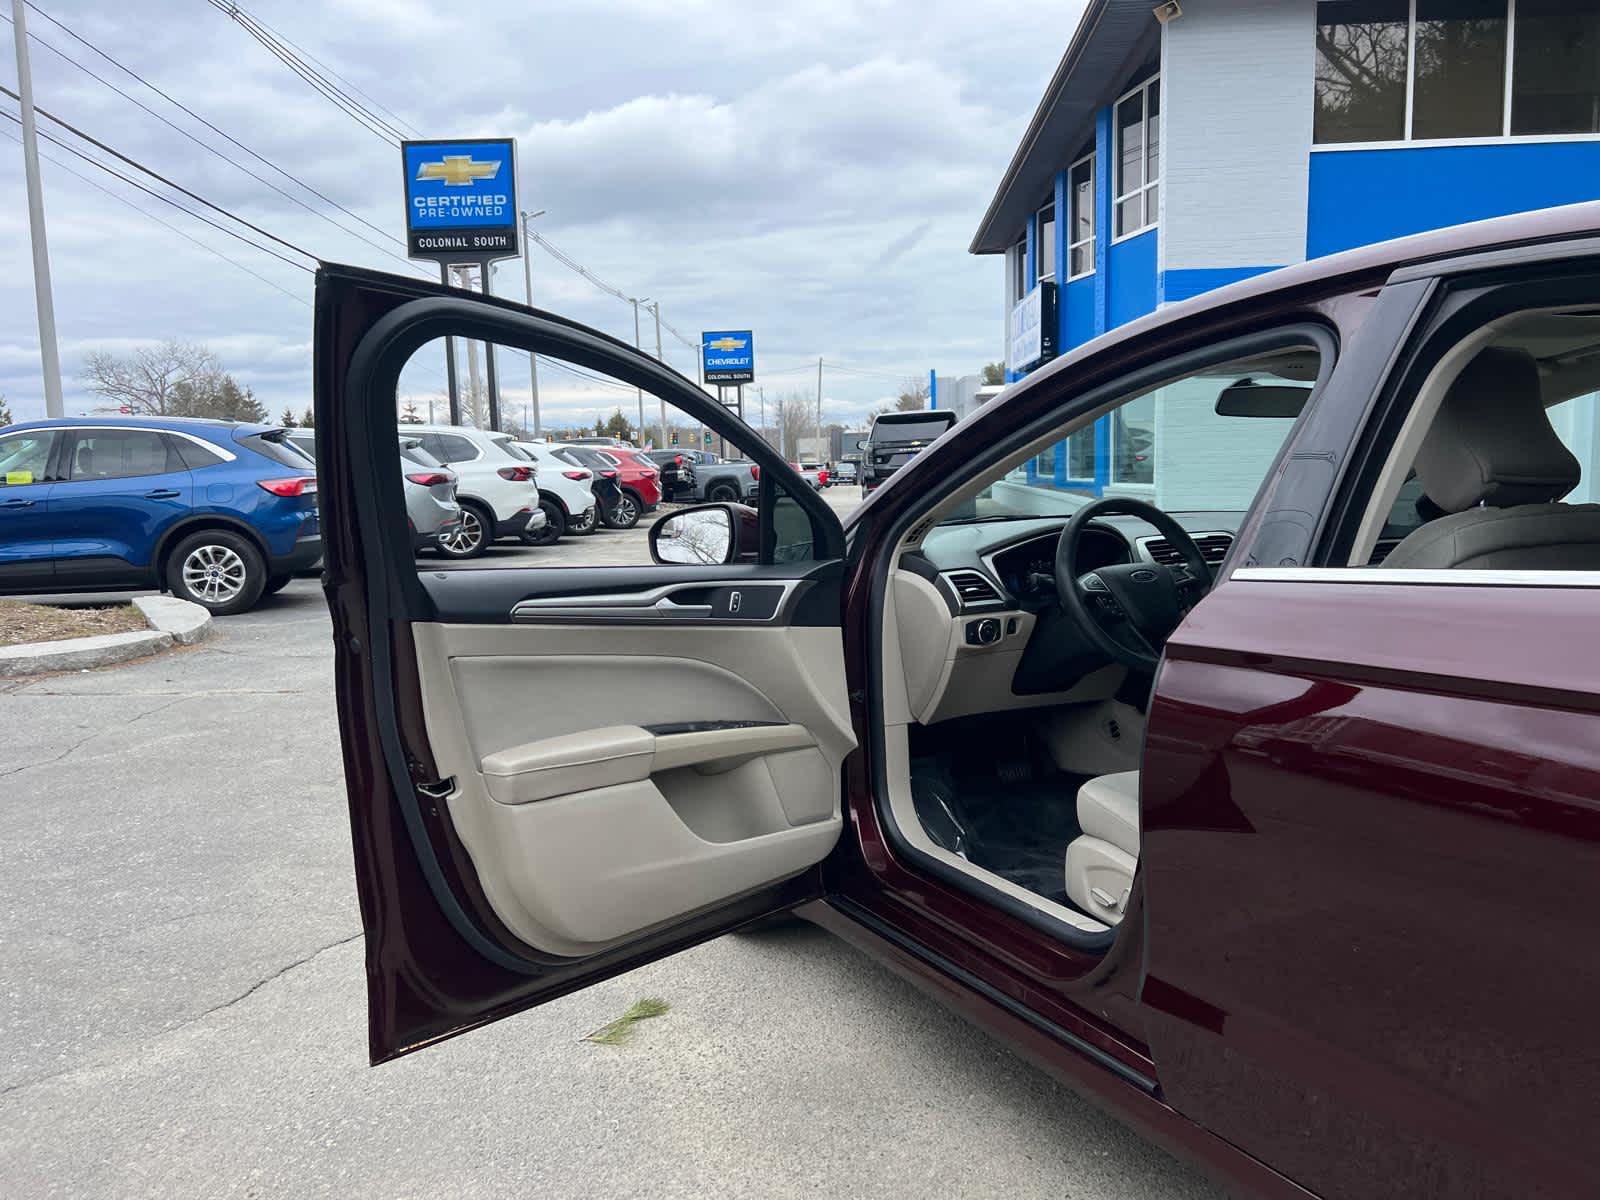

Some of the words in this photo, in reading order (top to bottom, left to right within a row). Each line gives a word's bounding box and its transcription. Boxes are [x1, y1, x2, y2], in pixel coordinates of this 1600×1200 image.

[414, 195, 507, 207] CERTIFIED
[419, 206, 503, 218] PRE-OWNED
[419, 238, 468, 248] COLONIAL
[474, 236, 507, 246] SOUTH
